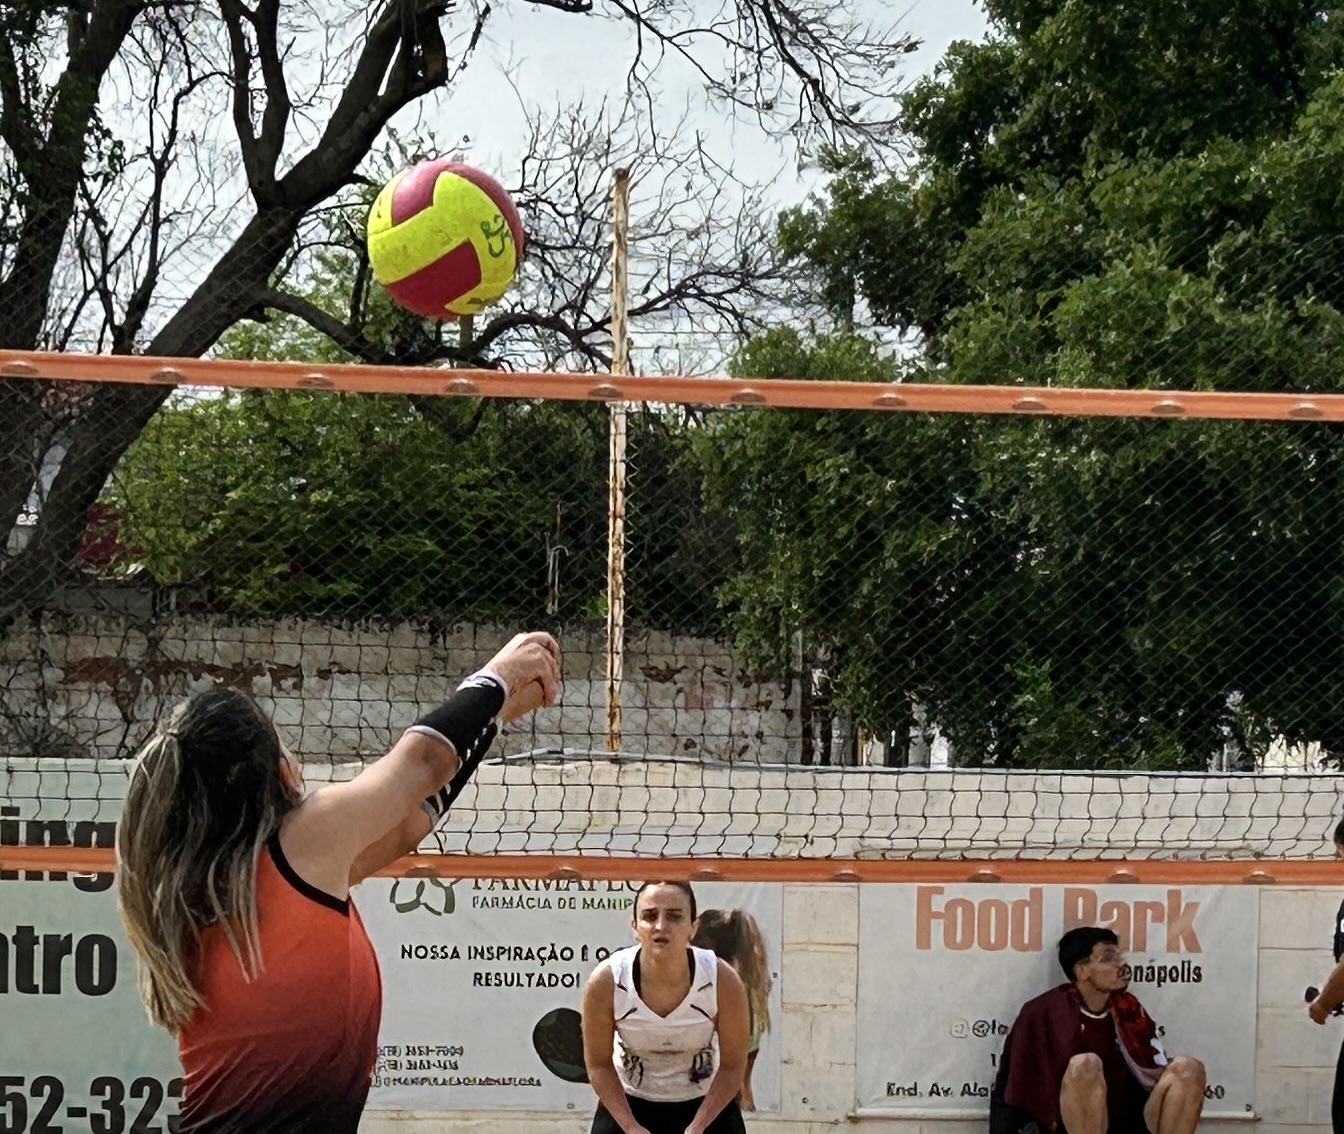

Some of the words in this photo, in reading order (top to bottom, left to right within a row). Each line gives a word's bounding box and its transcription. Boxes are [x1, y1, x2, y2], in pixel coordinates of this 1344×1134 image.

[472, 894, 553, 910] FARMÁCIA
[558, 897, 576, 910] DE
[916, 886, 1043, 951] Food
[1063, 887, 1203, 953] Park
[401, 944, 461, 960] NOSSA
[467, 943, 574, 966] INSPIRAÇÃO
[473, 971, 580, 989] RESULTADO!
